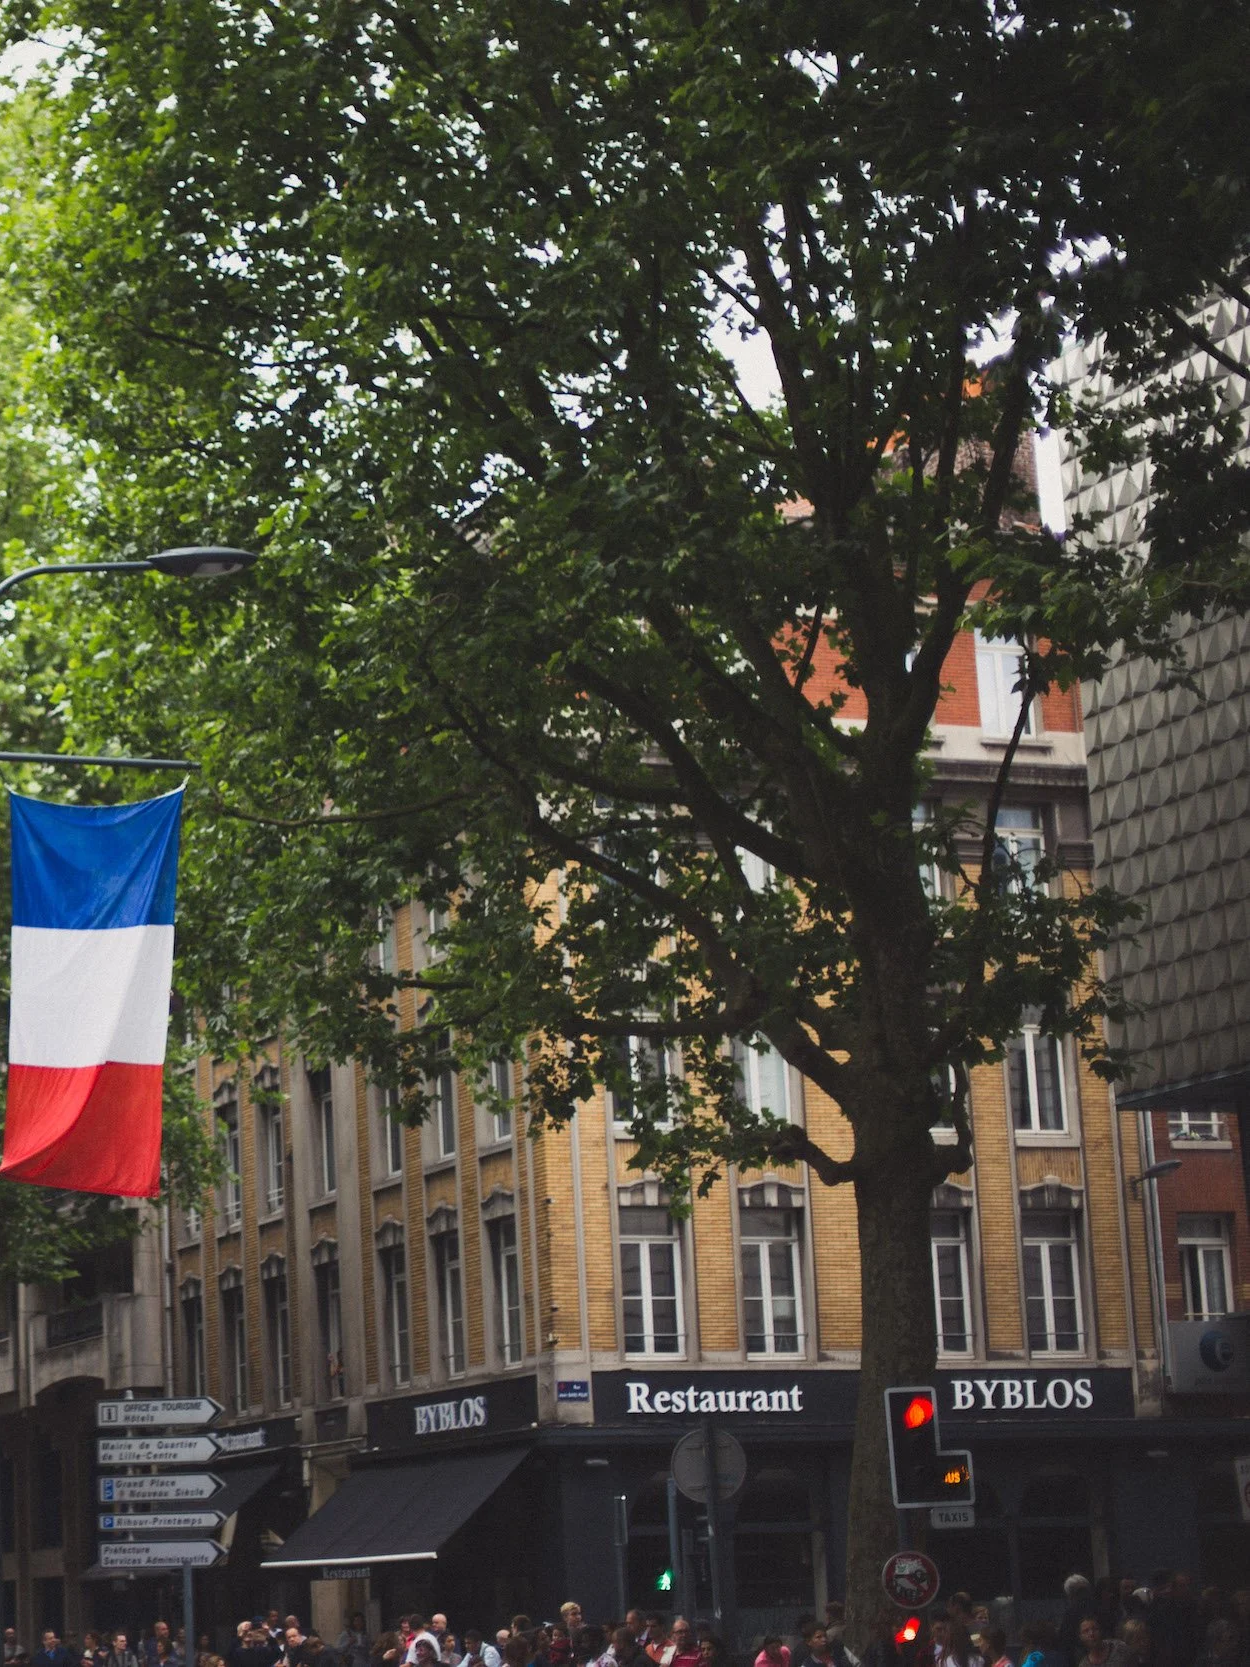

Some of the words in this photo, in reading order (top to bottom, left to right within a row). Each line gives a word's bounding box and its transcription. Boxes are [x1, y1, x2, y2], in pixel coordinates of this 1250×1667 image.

[624, 1382, 803, 1413] Restaurant
[950, 1378, 1094, 1410] BYBLOS
[123, 1404, 150, 1412] OFFICE
[161, 1402, 202, 1411] TOURISME
[414, 1396, 487, 1435] BYBLOS
[102, 1442, 132, 1450] Mairie
[139, 1441, 150, 1449] de
[157, 1440, 197, 1449] Quartier
[102, 1453, 113, 1461] de
[119, 1451, 178, 1460] Lille-Centre
[116, 1479, 144, 1488] Grand
[150, 1479, 176, 1487] Place
[129, 1489, 169, 1498] Nouveau
[117, 1516, 203, 1526] Rihour-Printemps
[103, 1545, 150, 1554] Préfecture
[103, 1556, 142, 1565] Services
